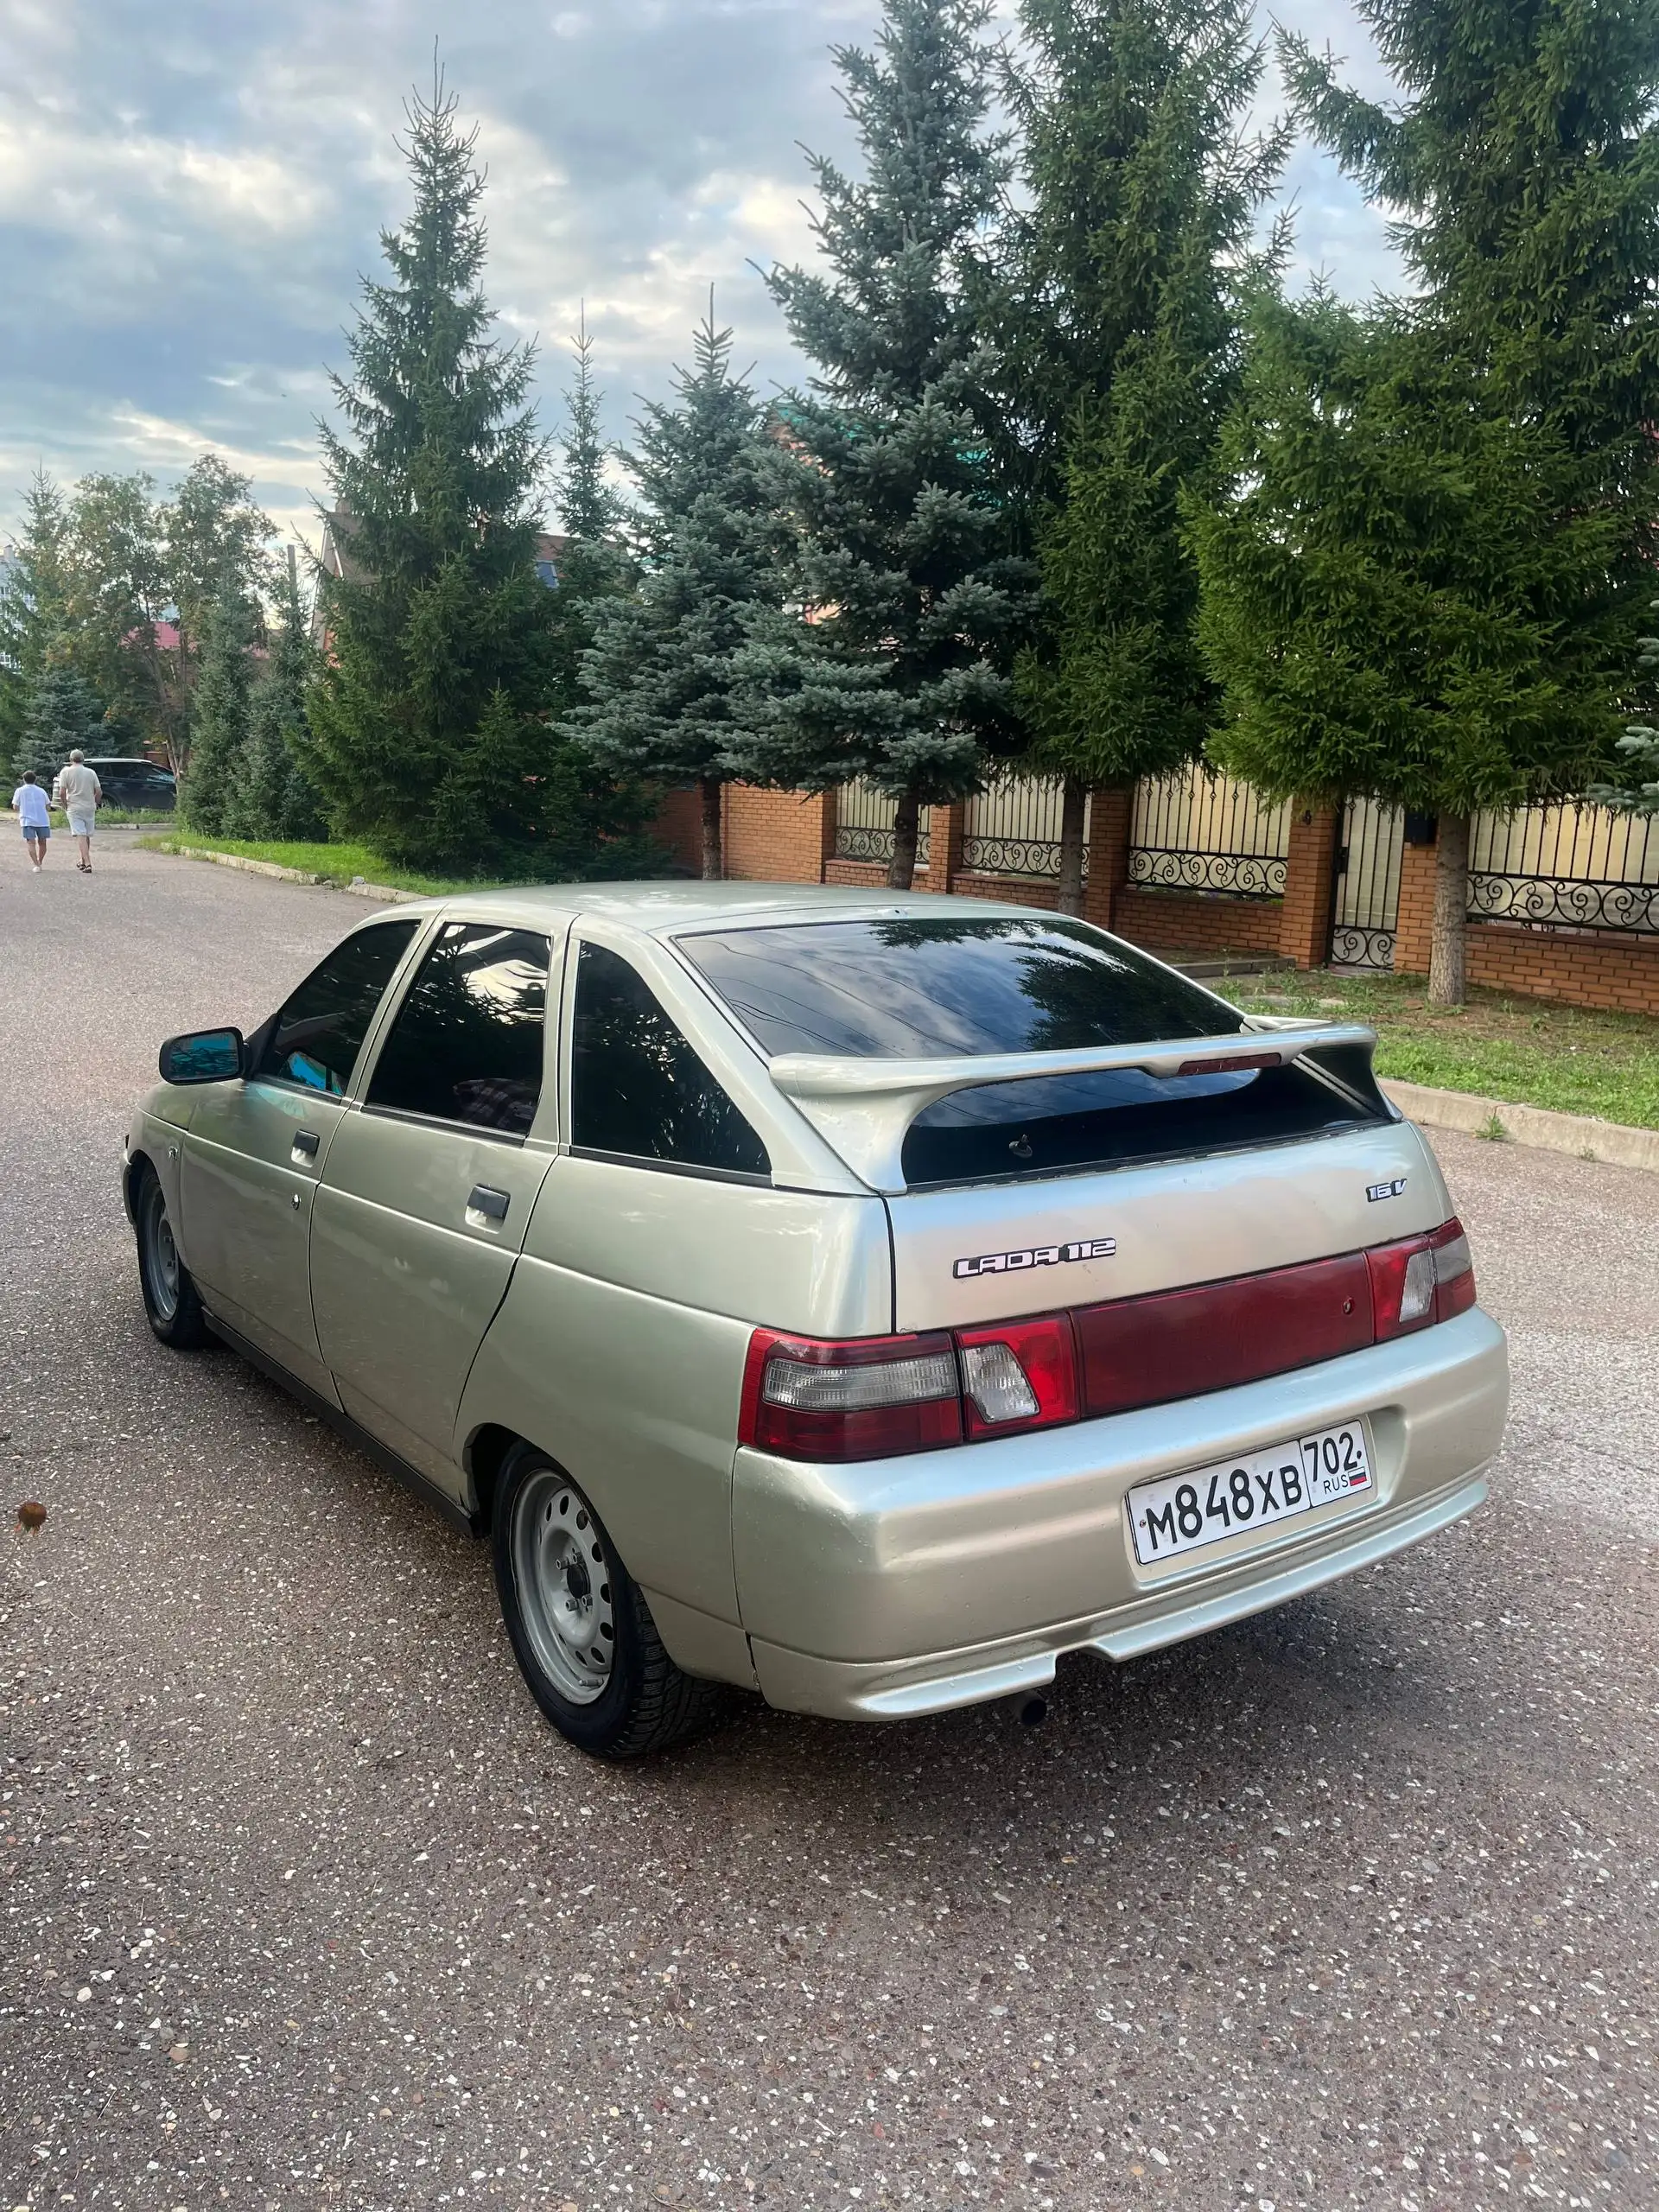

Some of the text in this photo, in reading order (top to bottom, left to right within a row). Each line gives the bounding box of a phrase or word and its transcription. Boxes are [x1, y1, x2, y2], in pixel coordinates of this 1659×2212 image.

[956, 1238, 1116, 1276] LADA 112
[1303, 1432, 1358, 1482] 702
[1323, 1474, 1349, 1495] RUS
